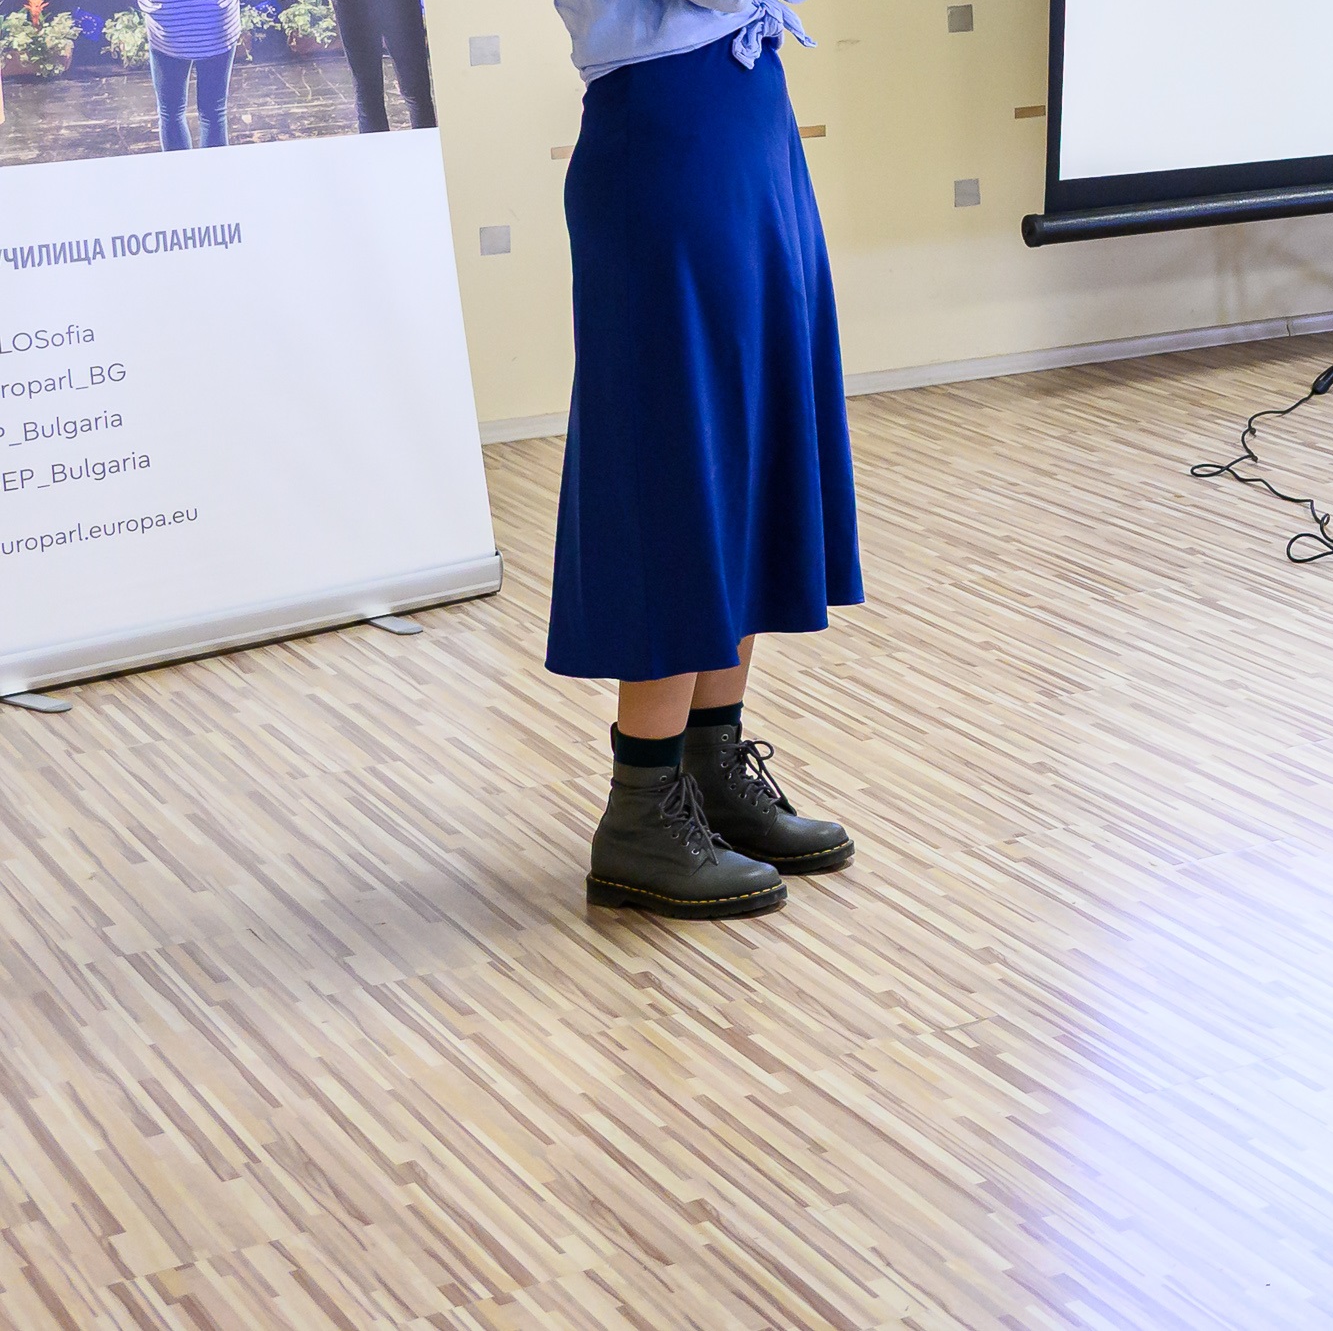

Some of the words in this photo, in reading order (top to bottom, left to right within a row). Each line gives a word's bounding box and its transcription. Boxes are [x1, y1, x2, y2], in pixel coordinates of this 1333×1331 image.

[112, 222, 242, 258] ПОСЛАНИЦИ
[2, 451, 151, 492] EP_Bulgaria
[1, 507, 198, 555] uroparl.europa.eu
